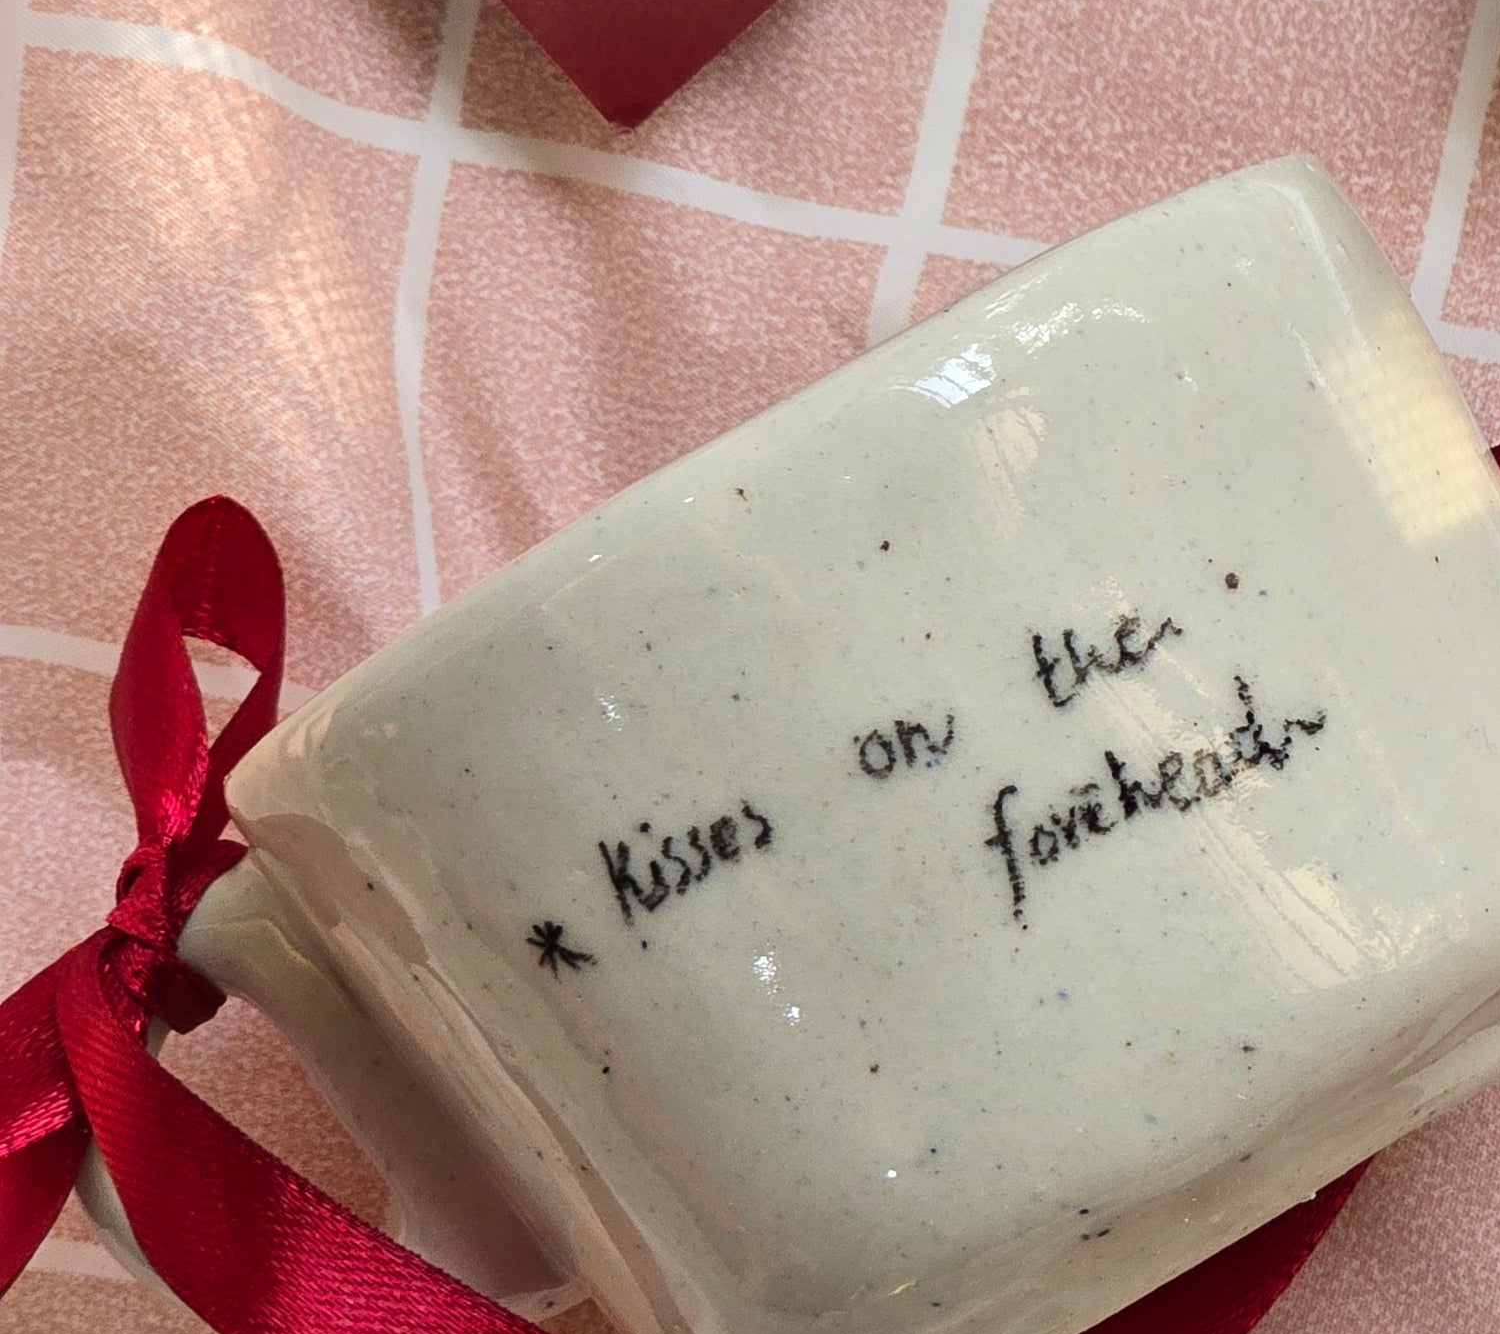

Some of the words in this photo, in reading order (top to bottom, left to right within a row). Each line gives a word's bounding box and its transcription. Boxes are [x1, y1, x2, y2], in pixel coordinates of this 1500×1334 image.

[855, 713, 955, 779] on
[1031, 615, 1184, 708] the
[984, 675, 1328, 920] forehead
